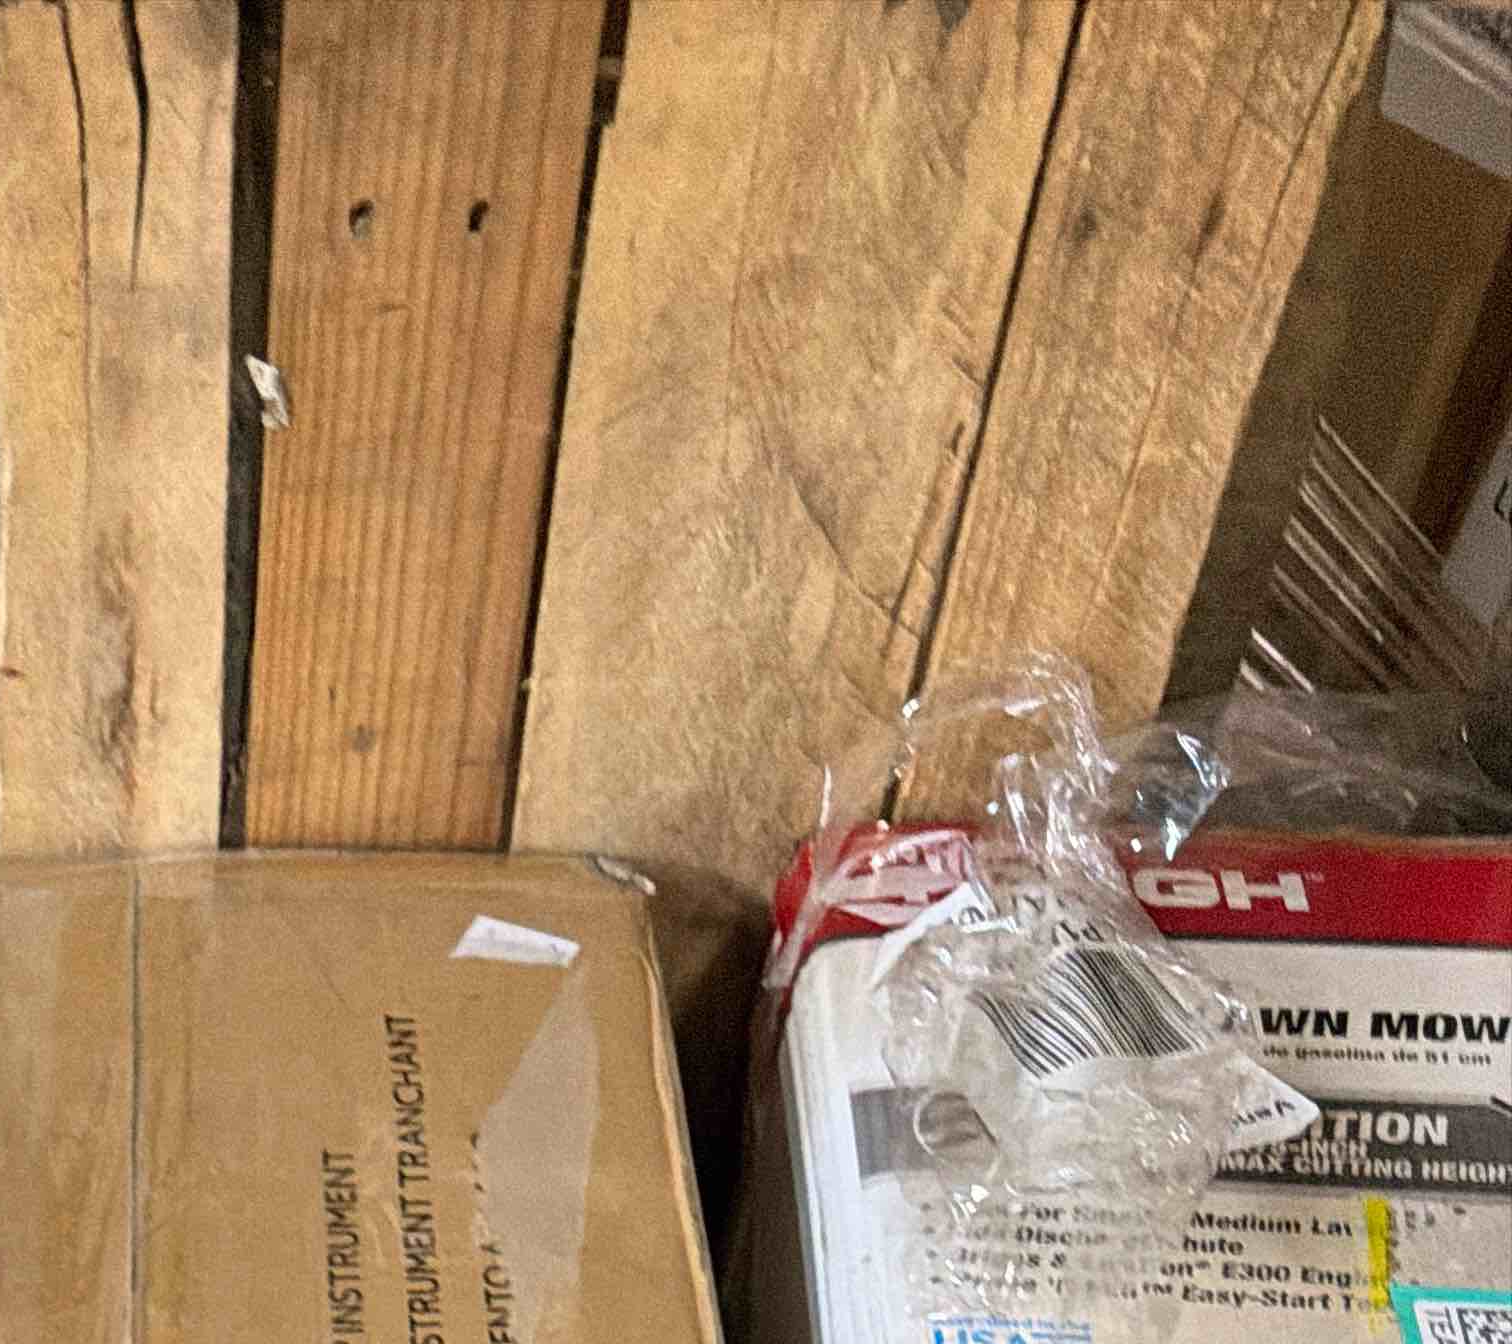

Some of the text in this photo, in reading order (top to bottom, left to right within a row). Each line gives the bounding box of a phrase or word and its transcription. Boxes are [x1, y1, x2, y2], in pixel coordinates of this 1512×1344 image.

[1259, 1007, 1512, 1042] WN MOW
[384, 1014, 431, 1187] TRANCHANT
[1293, 1157, 1413, 1180] CUTTING
[1190, 1212, 1301, 1236] Medium
[322, 1148, 365, 1334] INSTRUMENT
[1182, 1236, 1244, 1257] hute
[1221, 1263, 1291, 1283] E300
[1182, 1286, 1334, 1314] Easy-Start
